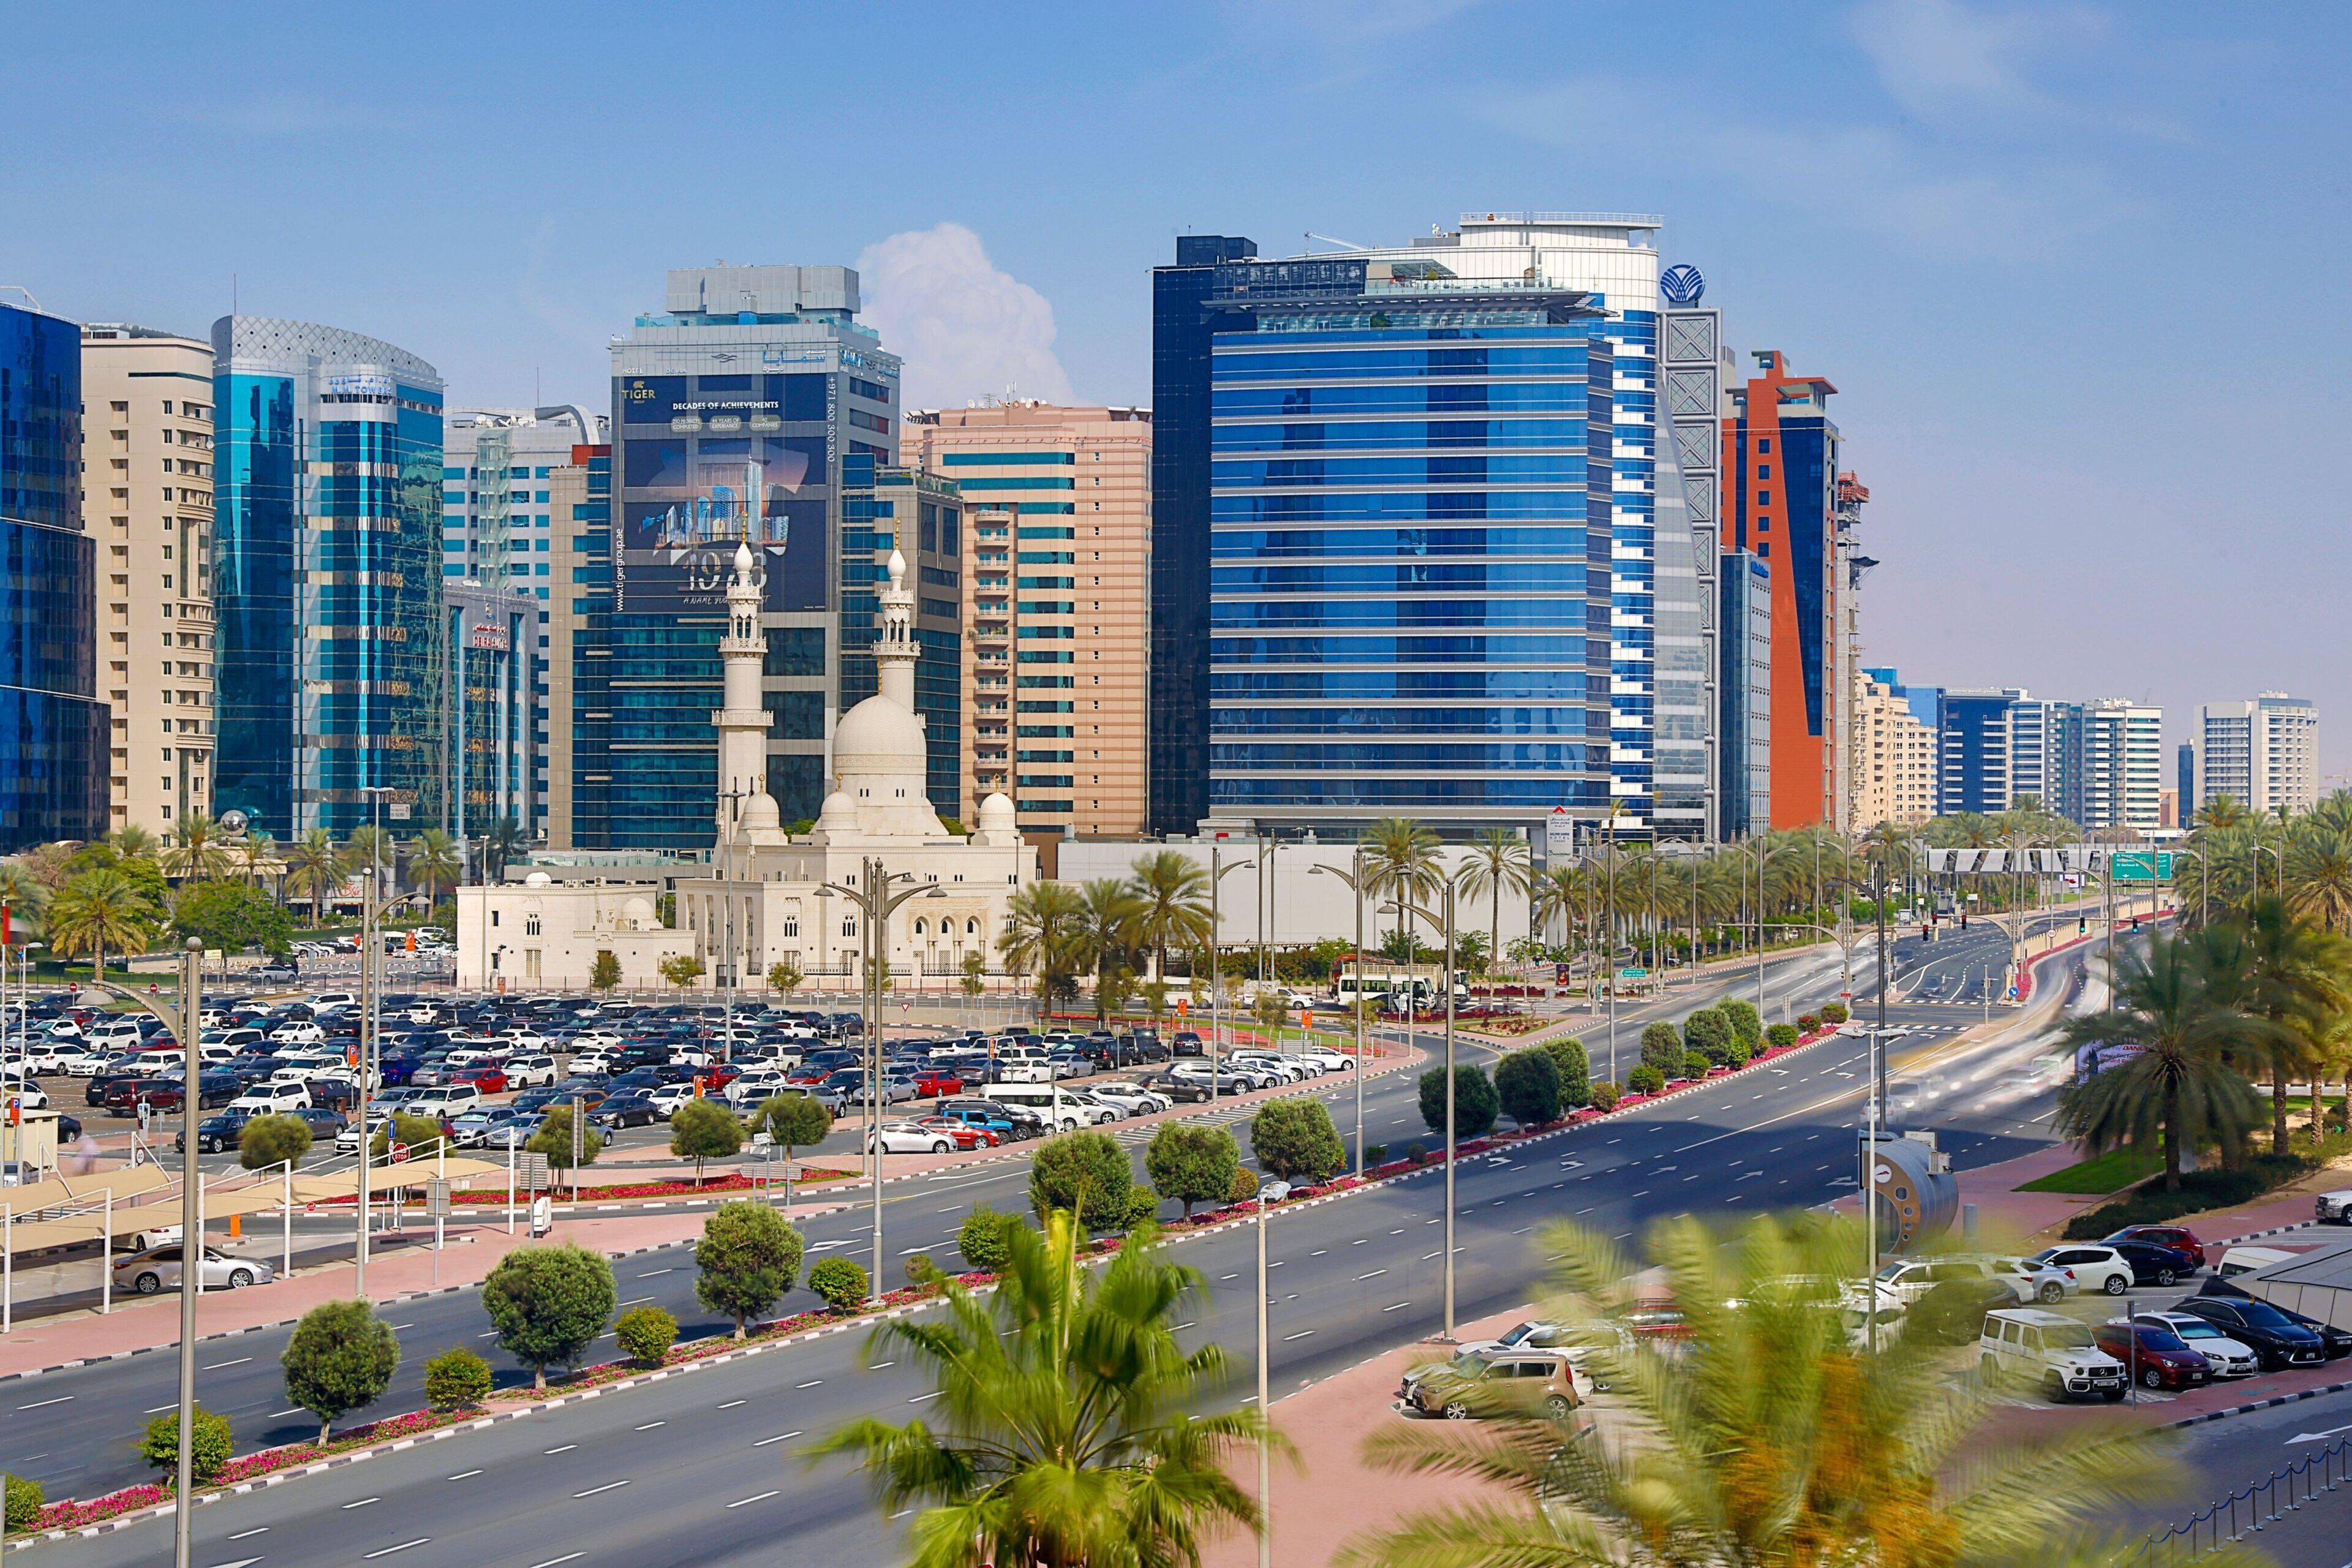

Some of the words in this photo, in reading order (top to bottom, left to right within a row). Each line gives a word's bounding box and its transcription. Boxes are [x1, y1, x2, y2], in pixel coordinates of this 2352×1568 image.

[355, 386, 392, 395] TOWERS
[621, 390, 656, 399] TIGER
[827, 424, 835, 442] 300
[13, 1099, 19, 1108] P
